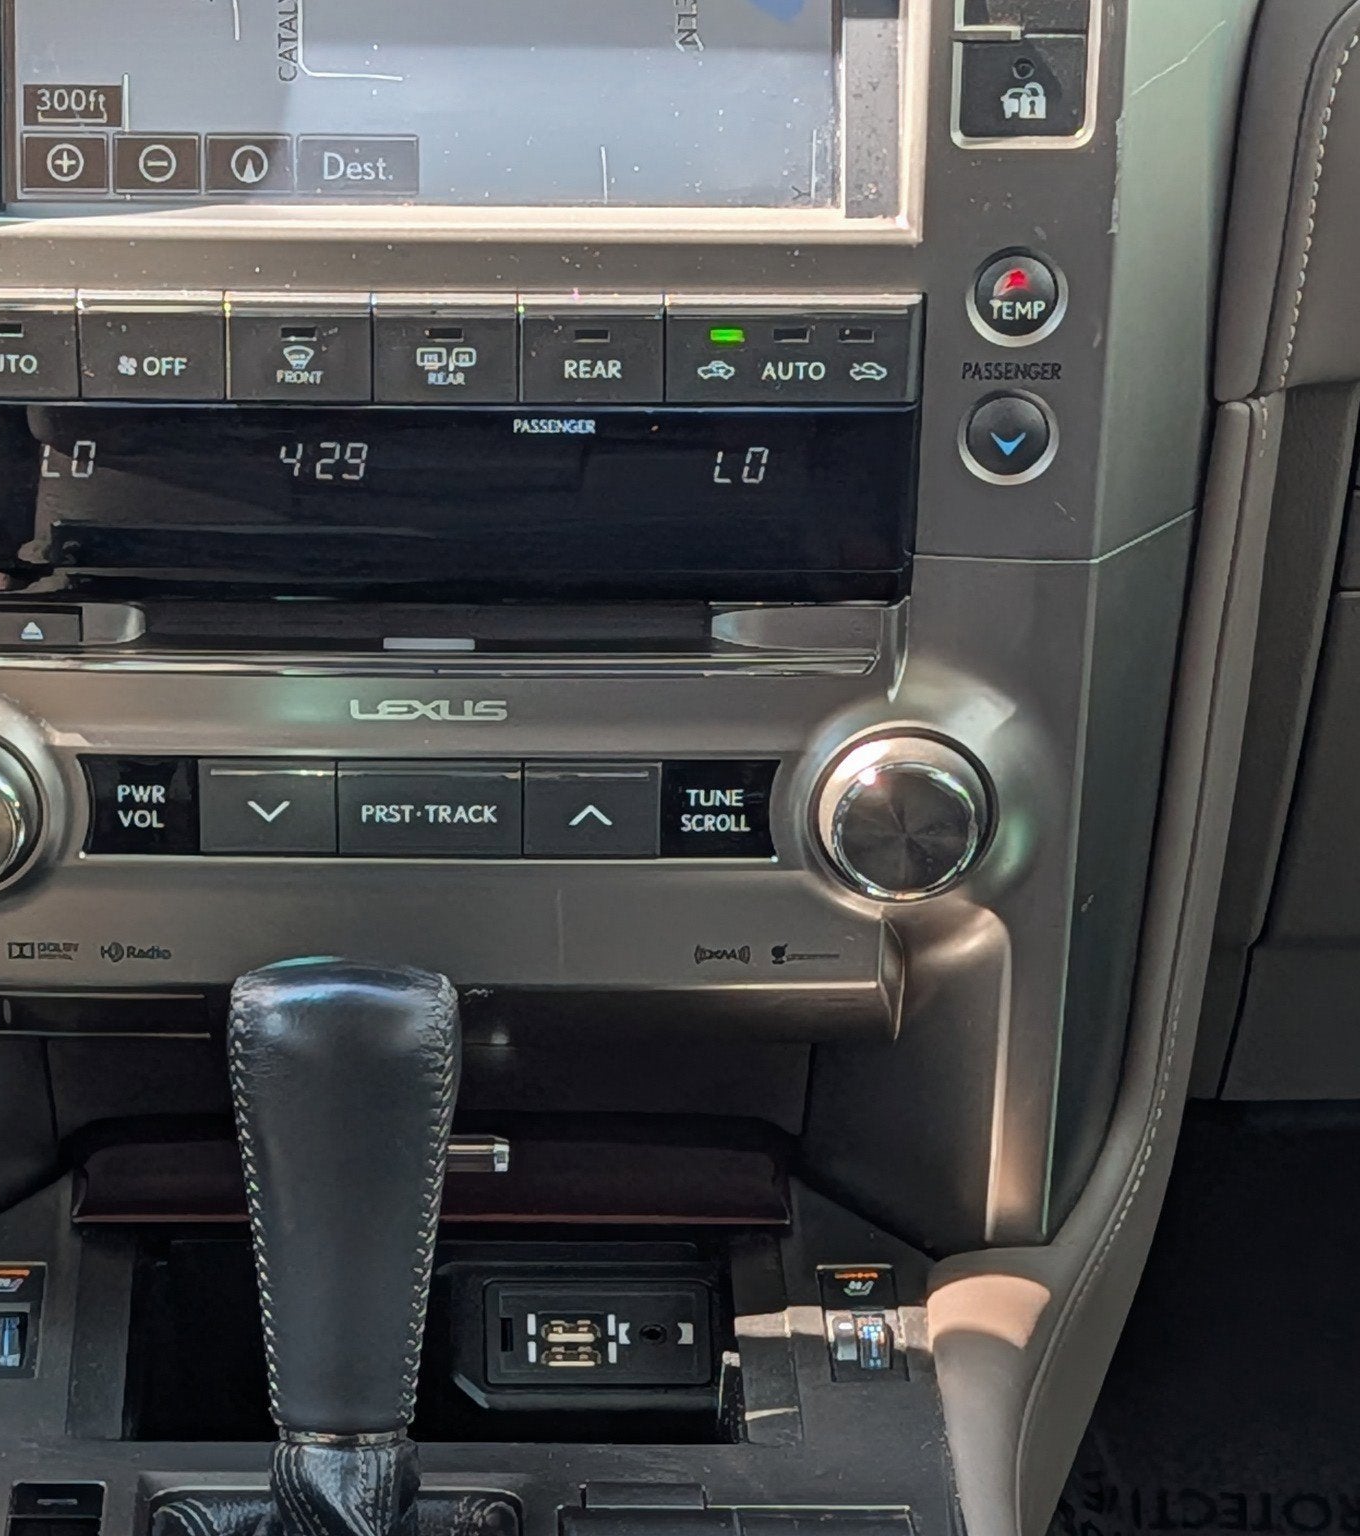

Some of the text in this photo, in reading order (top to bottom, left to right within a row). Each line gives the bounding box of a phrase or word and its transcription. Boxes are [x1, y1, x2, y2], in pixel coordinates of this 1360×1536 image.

[277, 0, 299, 82] CATAL
[36, 88, 106, 112] 300ft
[323, 150, 394, 182] Dest.
[989, 299, 1046, 321] TEMP
[142, 356, 188, 376] OFF
[563, 359, 623, 379] REAR
[761, 361, 826, 382] AUTO
[961, 361, 1063, 381] PASSENGER
[276, 370, 324, 385] FRONT
[427, 371, 466, 386] REAR
[512, 418, 596, 434] PASSENGER
[349, 698, 508, 721] LEXUS
[116, 784, 166, 803] PWR
[686, 788, 744, 807] TUNE
[117, 809, 165, 829] VOL
[680, 813, 751, 833] SCROLL
